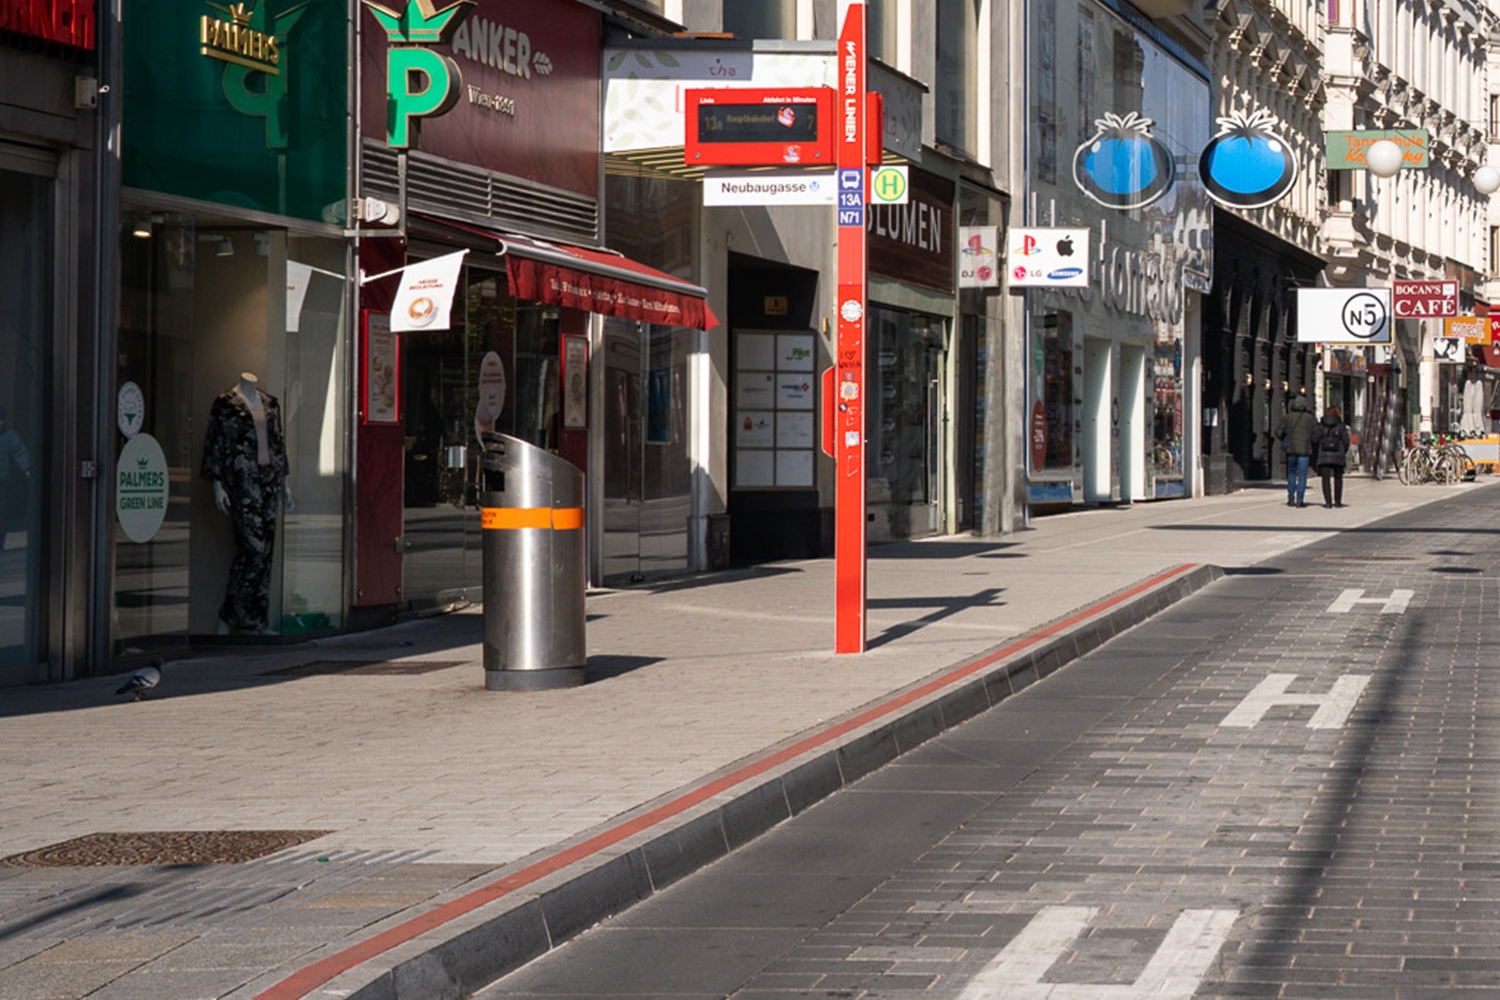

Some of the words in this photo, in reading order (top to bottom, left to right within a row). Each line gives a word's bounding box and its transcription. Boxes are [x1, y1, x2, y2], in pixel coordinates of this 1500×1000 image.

[200, 14, 280, 65] PALMERS
[452, 14, 531, 80] ANKER
[845, 41, 858, 95] WIENER
[845, 98, 857, 143] LINIEN
[721, 181, 807, 196] Neubaugasse
[881, 175, 898, 195] H
[840, 194, 861, 206] 13A
[840, 211, 860, 224] N71
[1395, 285, 1442, 295] BOCAN'S
[1395, 295, 1456, 316] CAFÉ
[119, 471, 165, 488] PALMERS
[119, 496, 147, 510] GREEN
[147, 496, 165, 510] LINE
